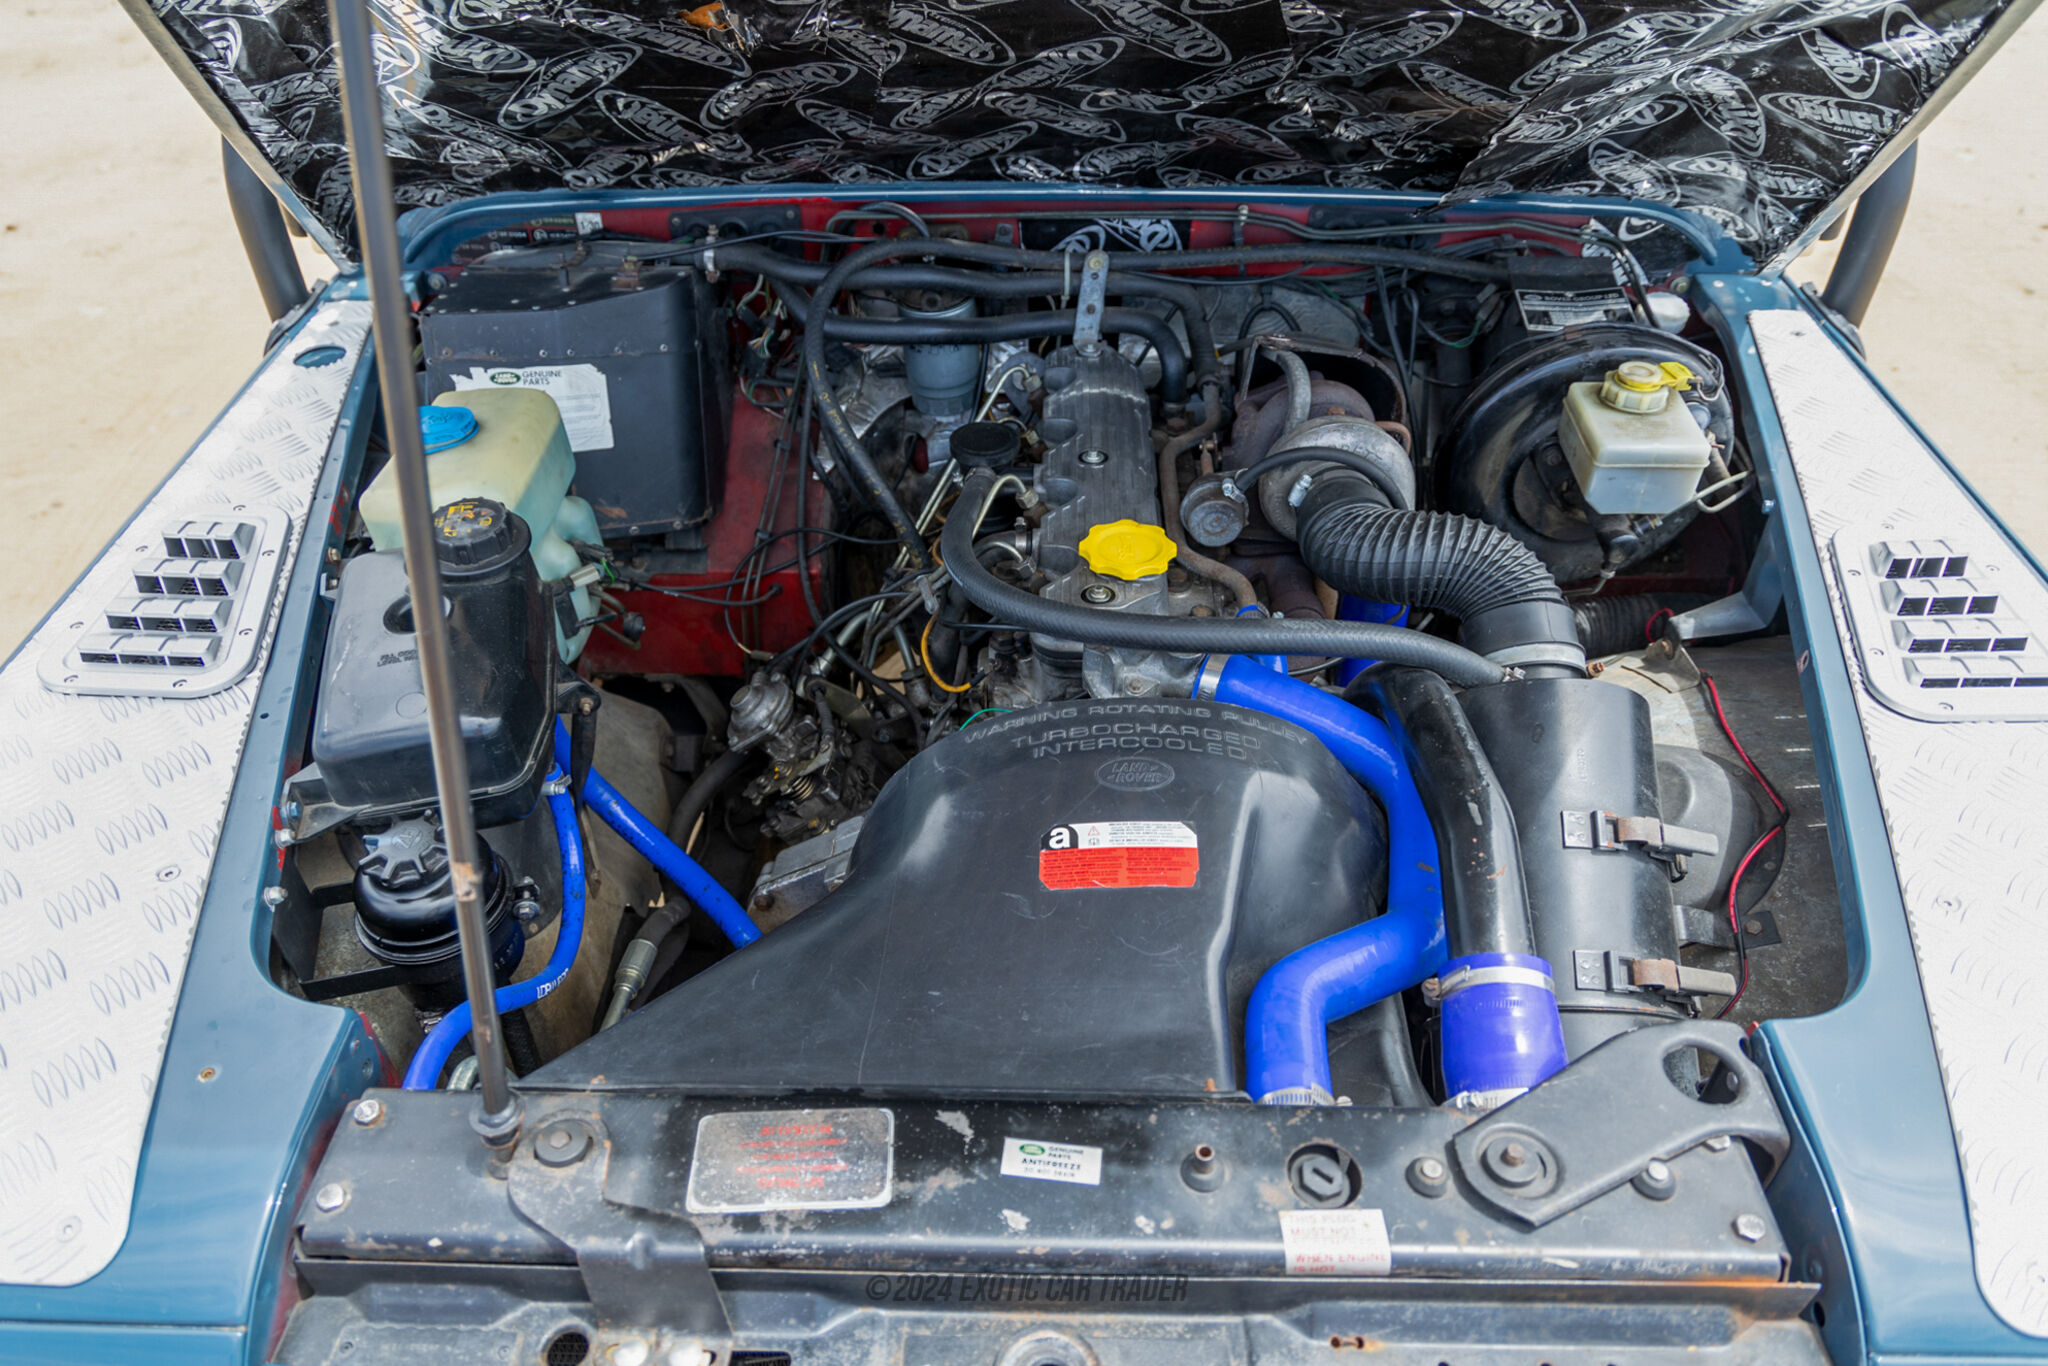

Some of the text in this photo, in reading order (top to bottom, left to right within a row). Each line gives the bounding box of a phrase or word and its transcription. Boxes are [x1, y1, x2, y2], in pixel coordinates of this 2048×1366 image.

[522, 370, 562, 379] GENUINE
[522, 377, 551, 386] PARTS
[965, 703, 1308, 745] WARNING ROTATING PULLEY
[1010, 722, 1261, 750] TURBOCHARGED
[1032, 736, 1247, 761] INTERCOOLED
[1048, 826, 1071, 850] a
[1022, 1157, 1081, 1170] ANTIFREEZE
